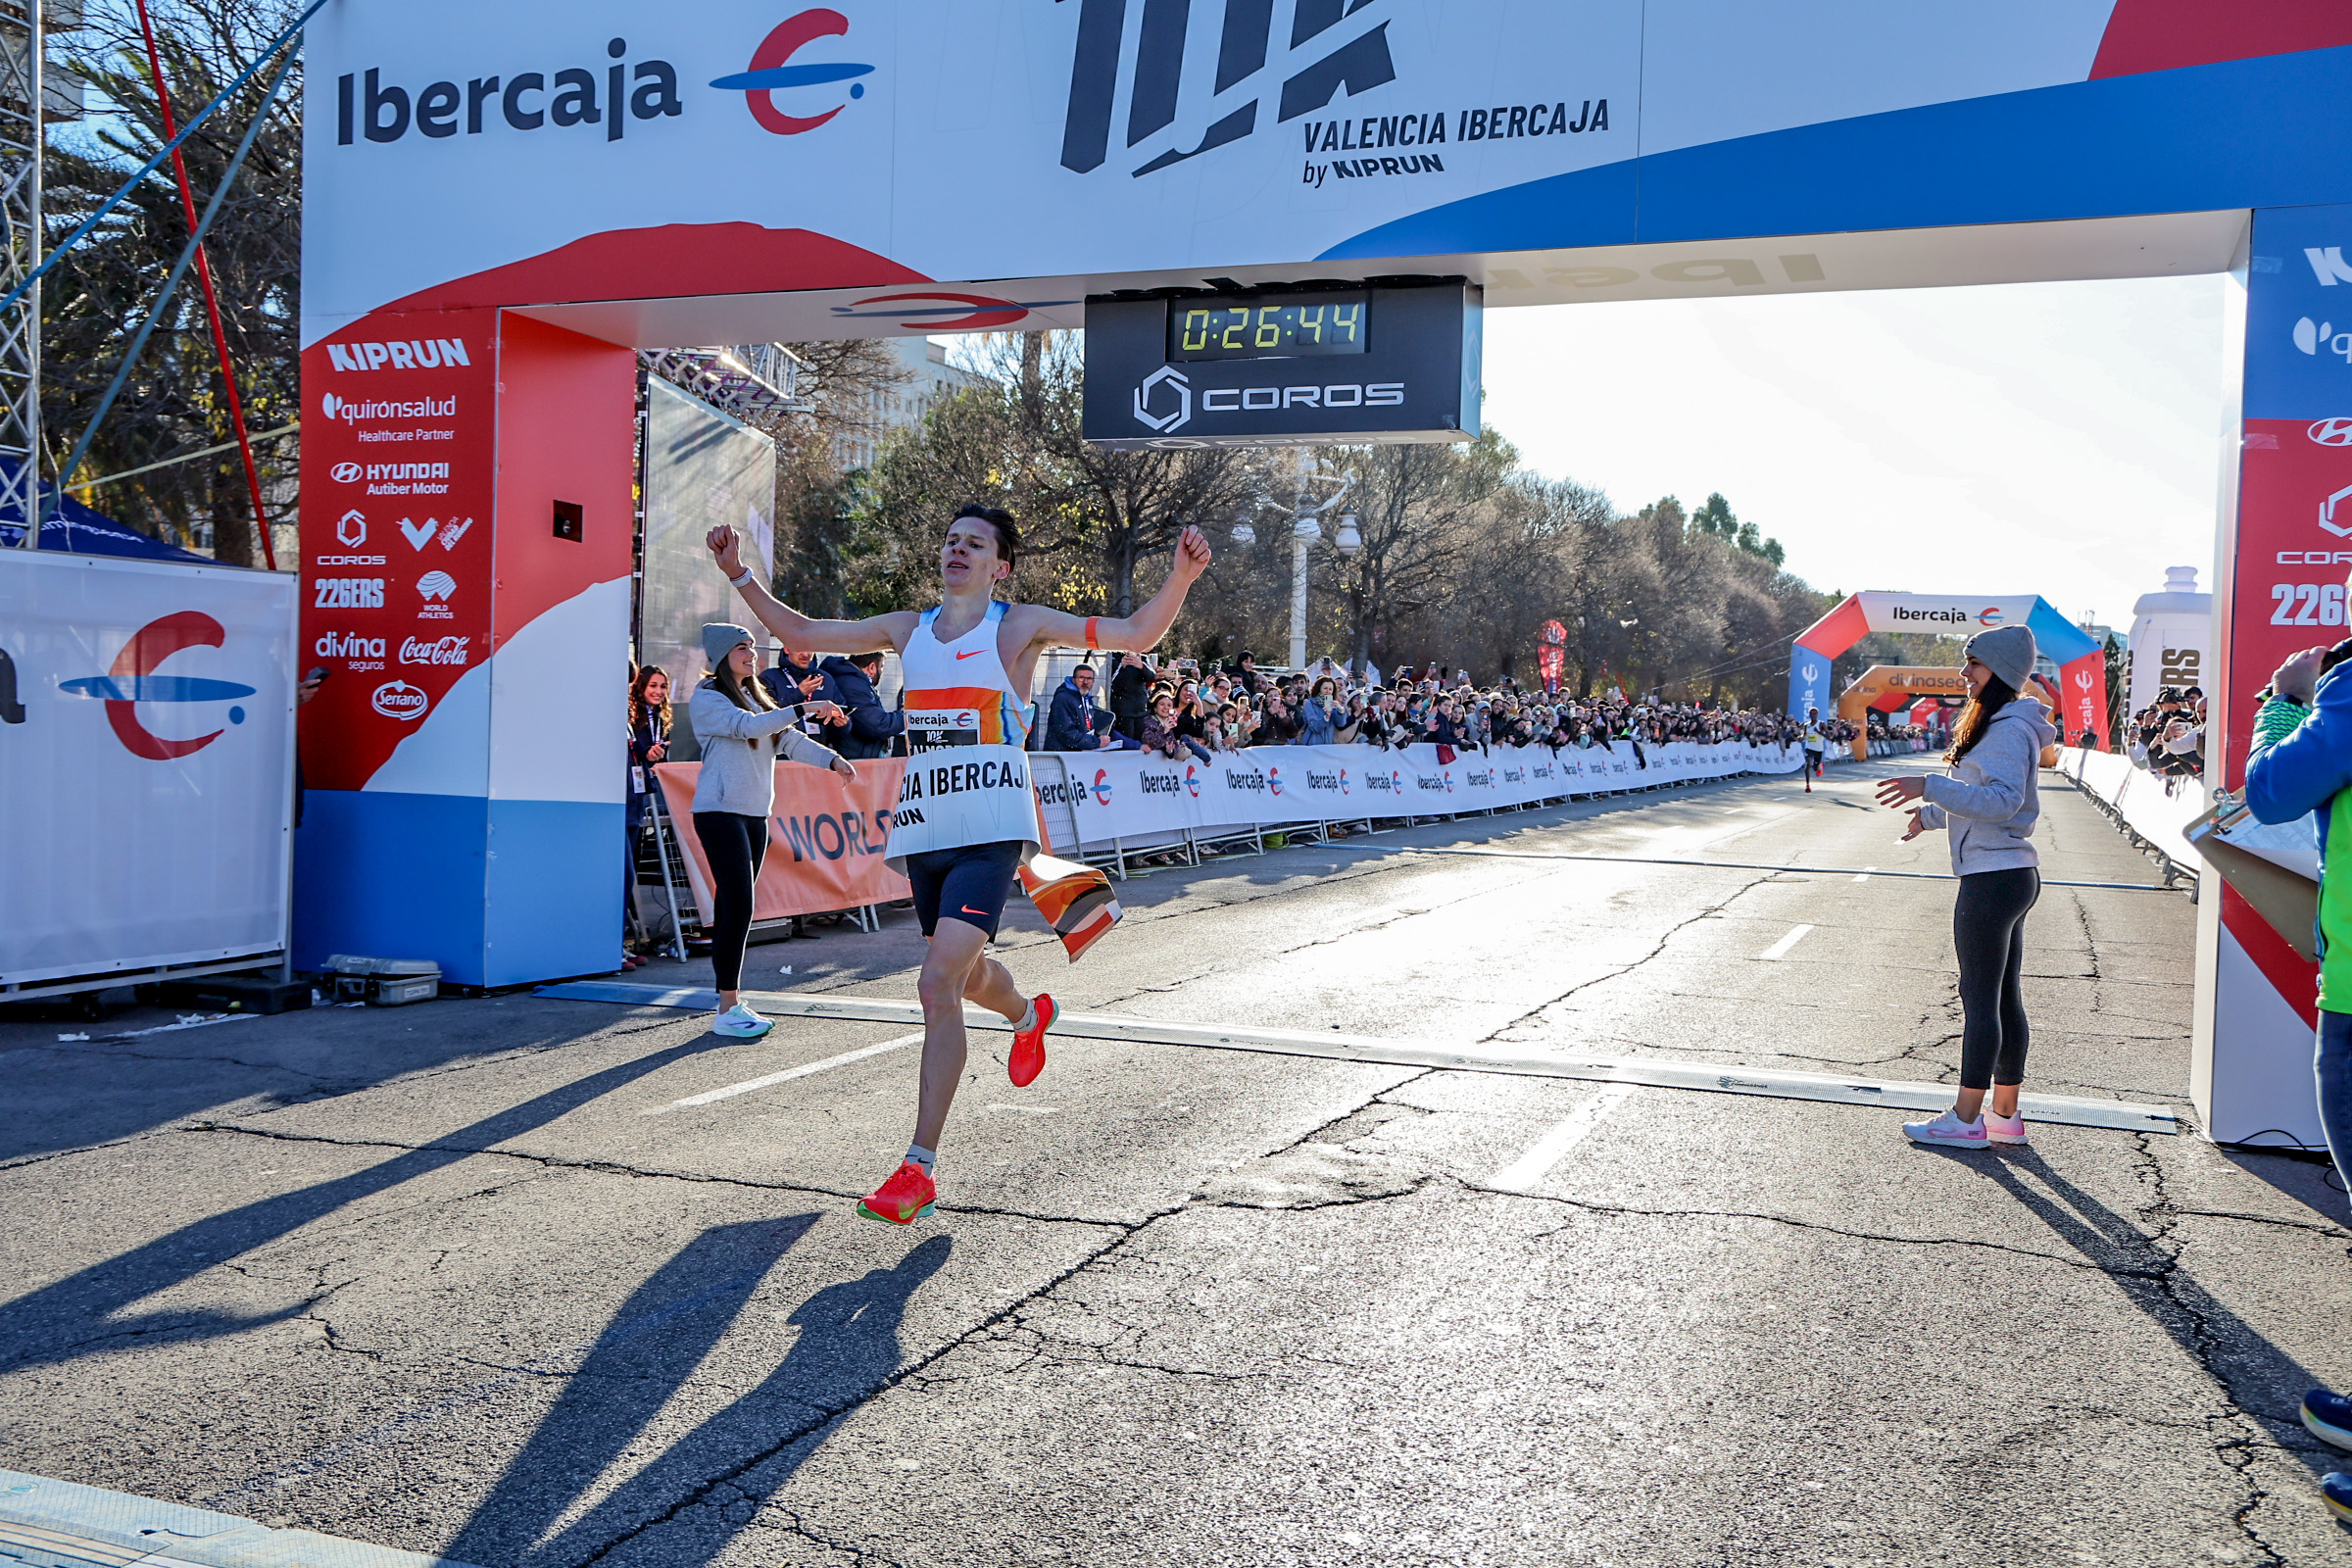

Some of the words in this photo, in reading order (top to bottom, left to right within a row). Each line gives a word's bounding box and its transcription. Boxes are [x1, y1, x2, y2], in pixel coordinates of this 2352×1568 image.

[338, 37, 682, 145] Ibercaja
[1303, 112, 1446, 153] VALENCIA
[1457, 99, 1610, 143] IBERCAJA
[1302, 160, 1328, 188] by
[1332, 154, 1446, 179] KIPRUN
[1182, 304, 1359, 351] 0:26:44
[326, 338, 471, 371] KIPRUN
[1202, 382, 1405, 412] COROS
[341, 395, 456, 425] quirónsalud
[358, 430, 414, 442] Healthcare
[416, 429, 455, 440] Partner
[367, 463, 450, 479] HYUNDAI
[366, 483, 411, 495] Autiber
[413, 482, 449, 494] Motor
[317, 556, 387, 565] COROS
[315, 578, 385, 608] 226ERS
[1892, 607, 1967, 624] Ibercaja
[316, 631, 386, 658] divina
[348, 661, 385, 672] seguros
[379, 690, 423, 706] Serrano
[908, 713, 950, 727] Ibercaja
[1140, 768, 1180, 797] Ibercaja
[1226, 767, 1265, 794] Ibercaja
[1306, 769, 1338, 794] Ibercaja
[1364, 771, 1391, 794] Ibercaja
[1417, 772, 1445, 793] Ibercaja
[1466, 769, 1490, 789] Ibercaja
